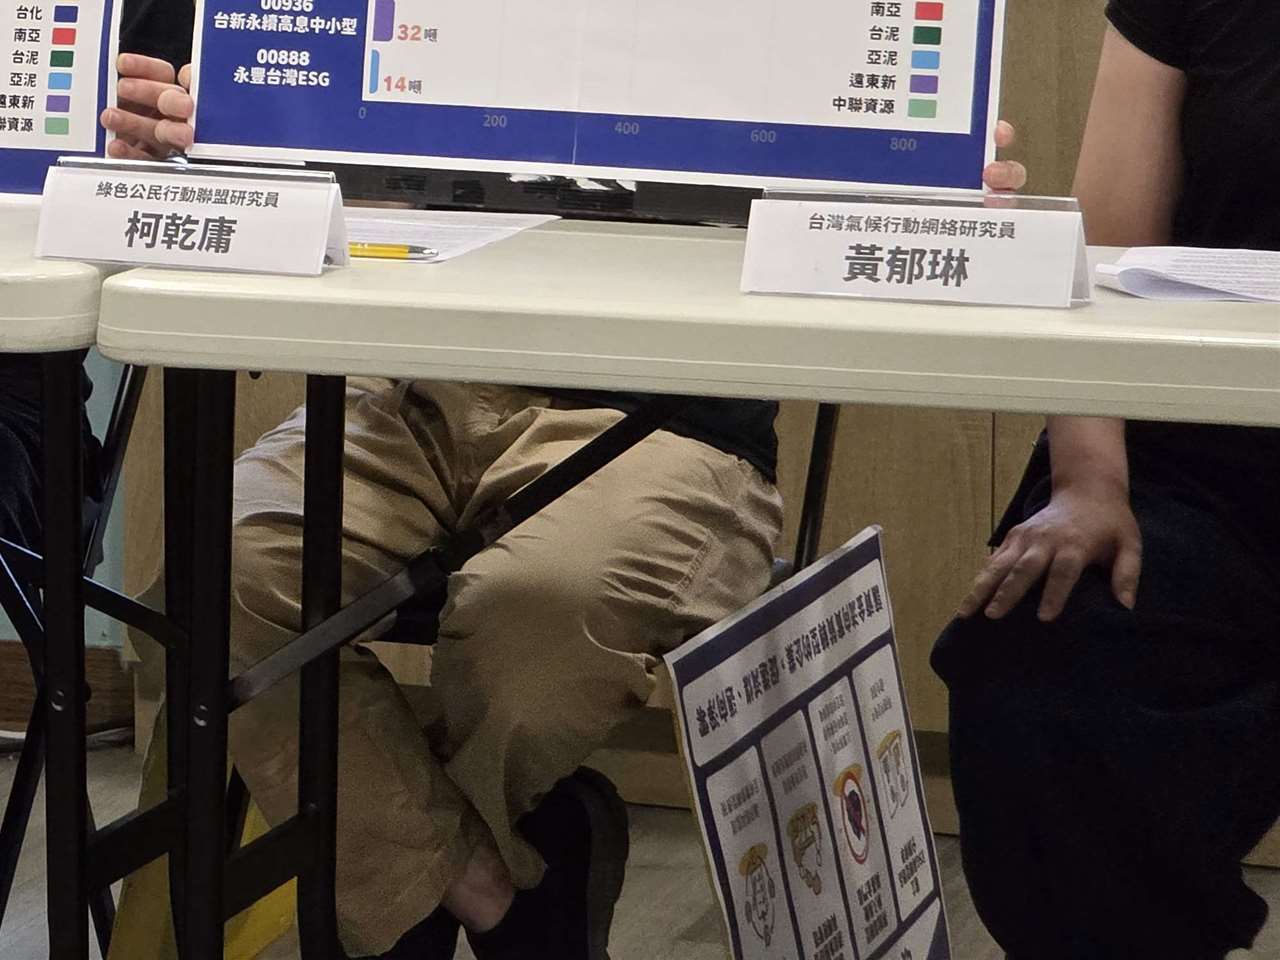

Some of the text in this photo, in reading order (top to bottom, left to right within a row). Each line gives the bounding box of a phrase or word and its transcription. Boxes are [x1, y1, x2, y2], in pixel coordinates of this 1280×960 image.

[16, 5, 43, 21] 台化
[870, 1, 902, 18] 南亞
[214, 12, 357, 35] 台新永續高息中小型
[13, 28, 41, 43] 南亞
[397, 24, 422, 41] 32
[869, 25, 900, 42] 台泥
[12, 50, 39, 66] 台泥
[256, 49, 310, 66] 00888
[866, 49, 898, 66] 亞泥
[9, 72, 37, 88] 亞泥
[233, 66, 330, 87] 永豐台灣ESG
[383, 75, 407, 93] 14
[848, 73, 897, 90] 遠東新
[832, 96, 895, 114] 中聯資源
[358, 107, 917, 151] 0 200 400 600 800
[95, 180, 280, 209] 綠色公民行動聯盟研究員
[124, 210, 238, 254] 柯乾庸
[808, 212, 1016, 239] 台灣氣候行動網絡研究員
[842, 243, 970, 287] 黃郁琳
